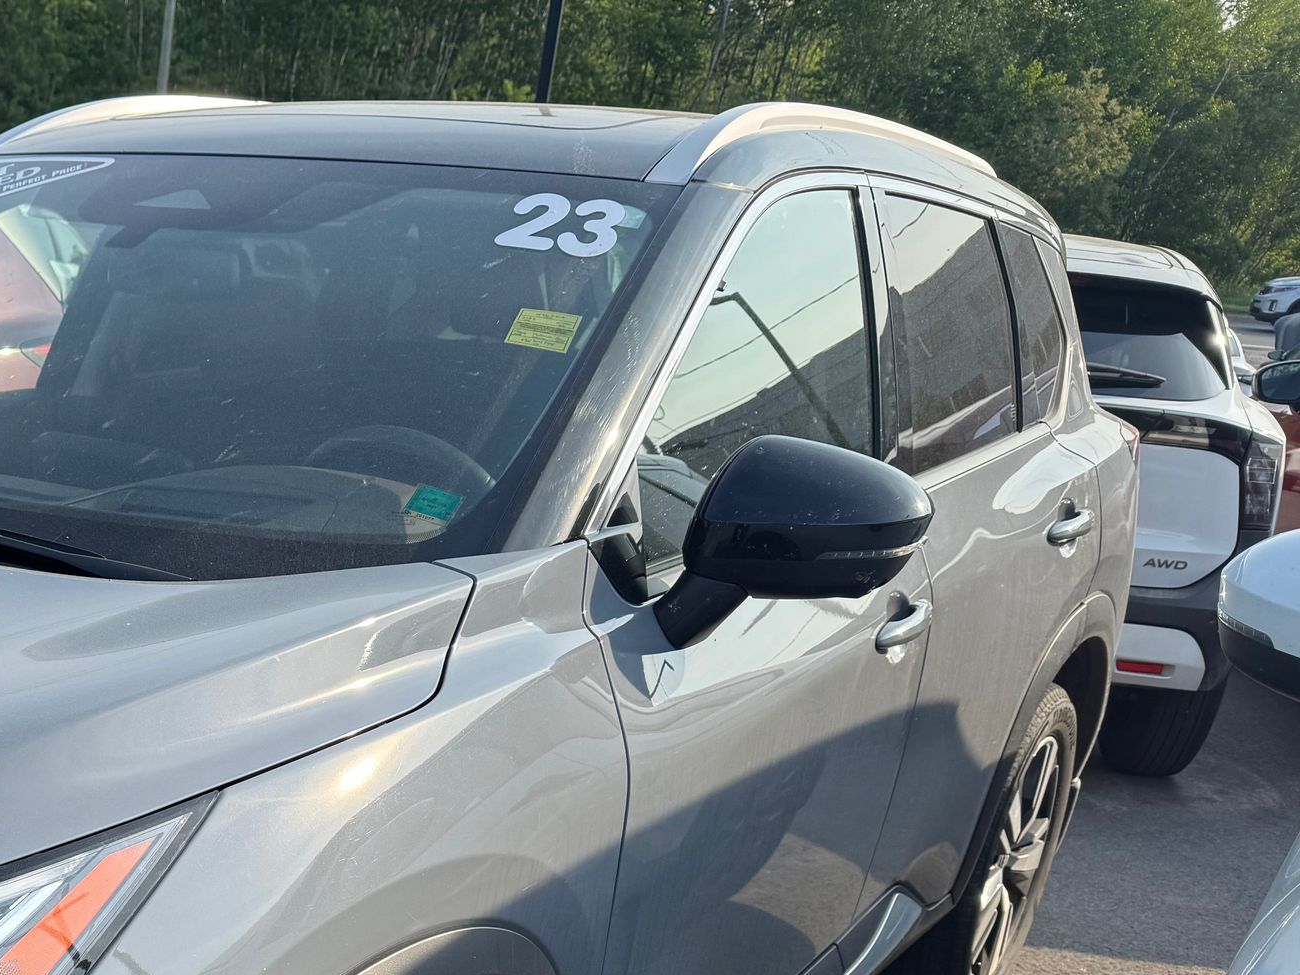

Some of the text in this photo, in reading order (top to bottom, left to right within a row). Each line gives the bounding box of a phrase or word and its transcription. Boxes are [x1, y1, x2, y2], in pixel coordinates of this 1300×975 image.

[2, 174, 47, 192] PERFECT
[494, 192, 626, 257] 23
[1142, 558, 1188, 571] AWD
